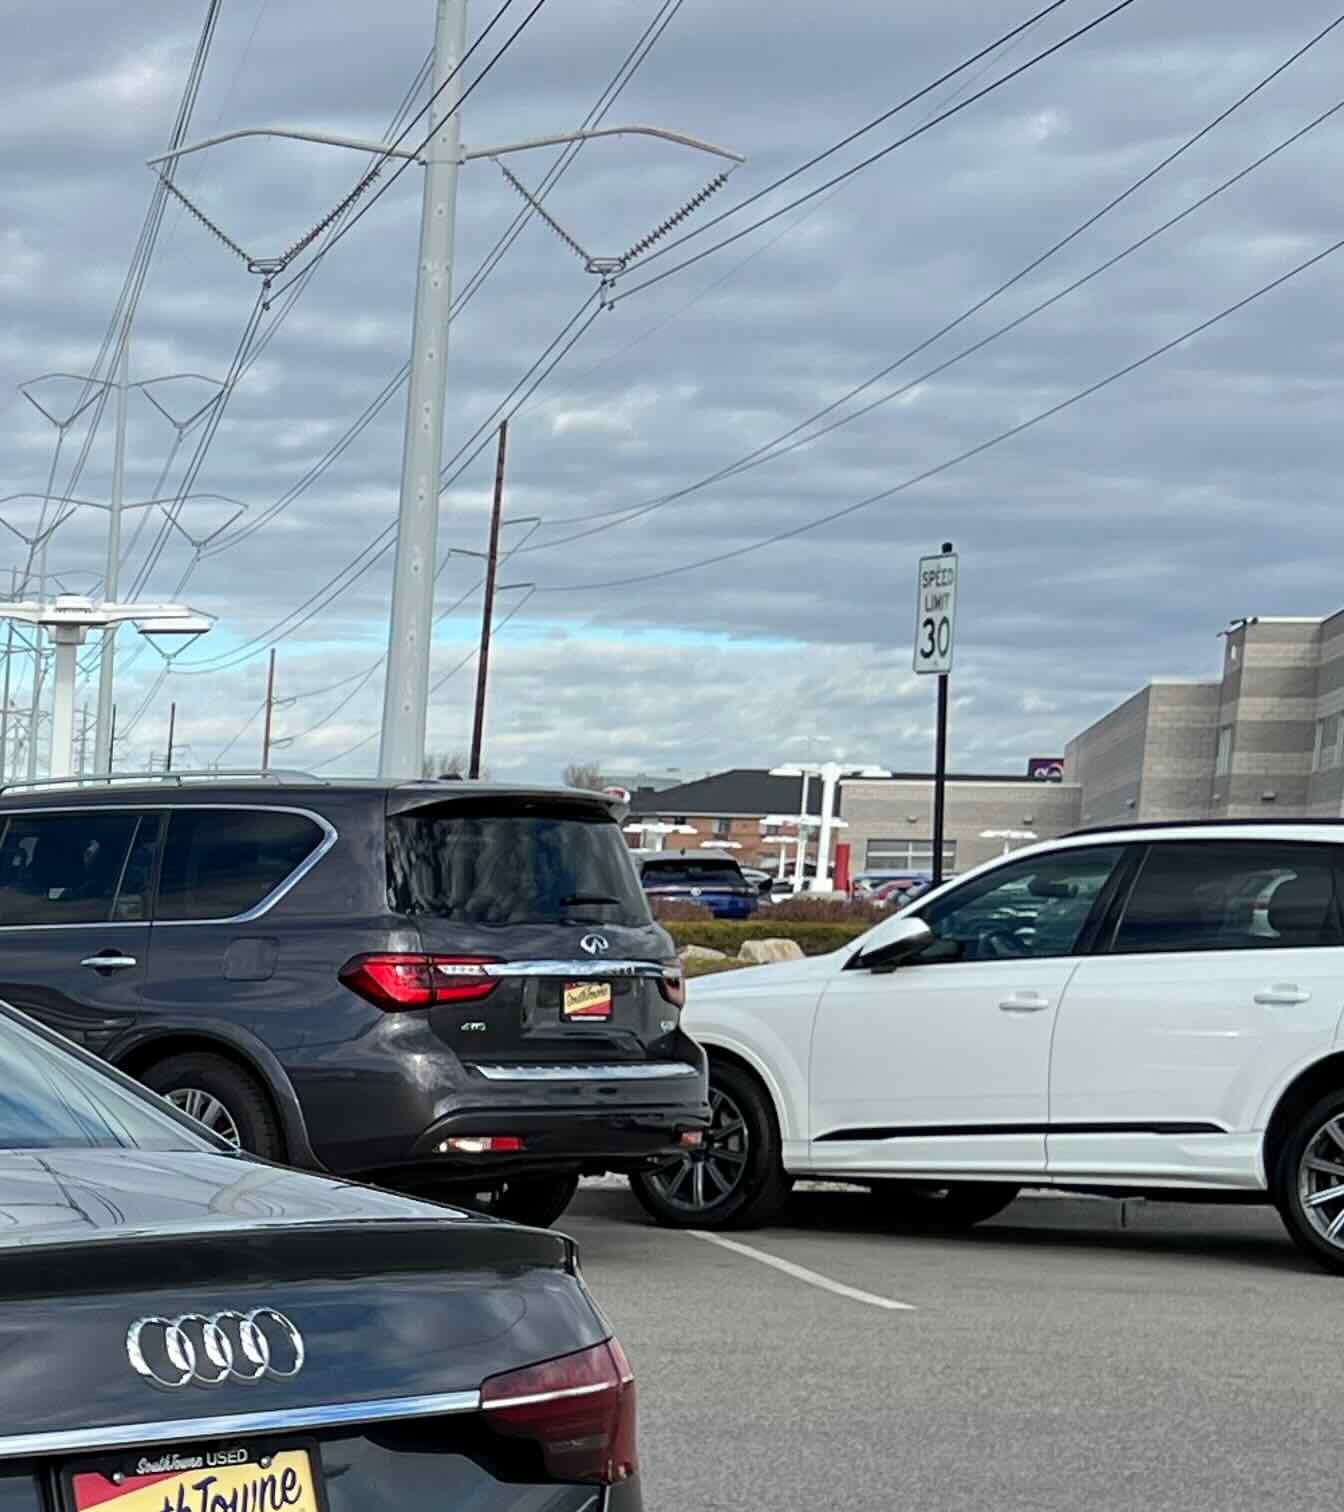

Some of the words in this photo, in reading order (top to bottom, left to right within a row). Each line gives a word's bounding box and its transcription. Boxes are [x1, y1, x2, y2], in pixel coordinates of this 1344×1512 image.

[922, 567, 954, 588] SPEED
[925, 592, 951, 613] LIMIT
[920, 616, 950, 659] 30
[206, 1448, 249, 1466] USED
